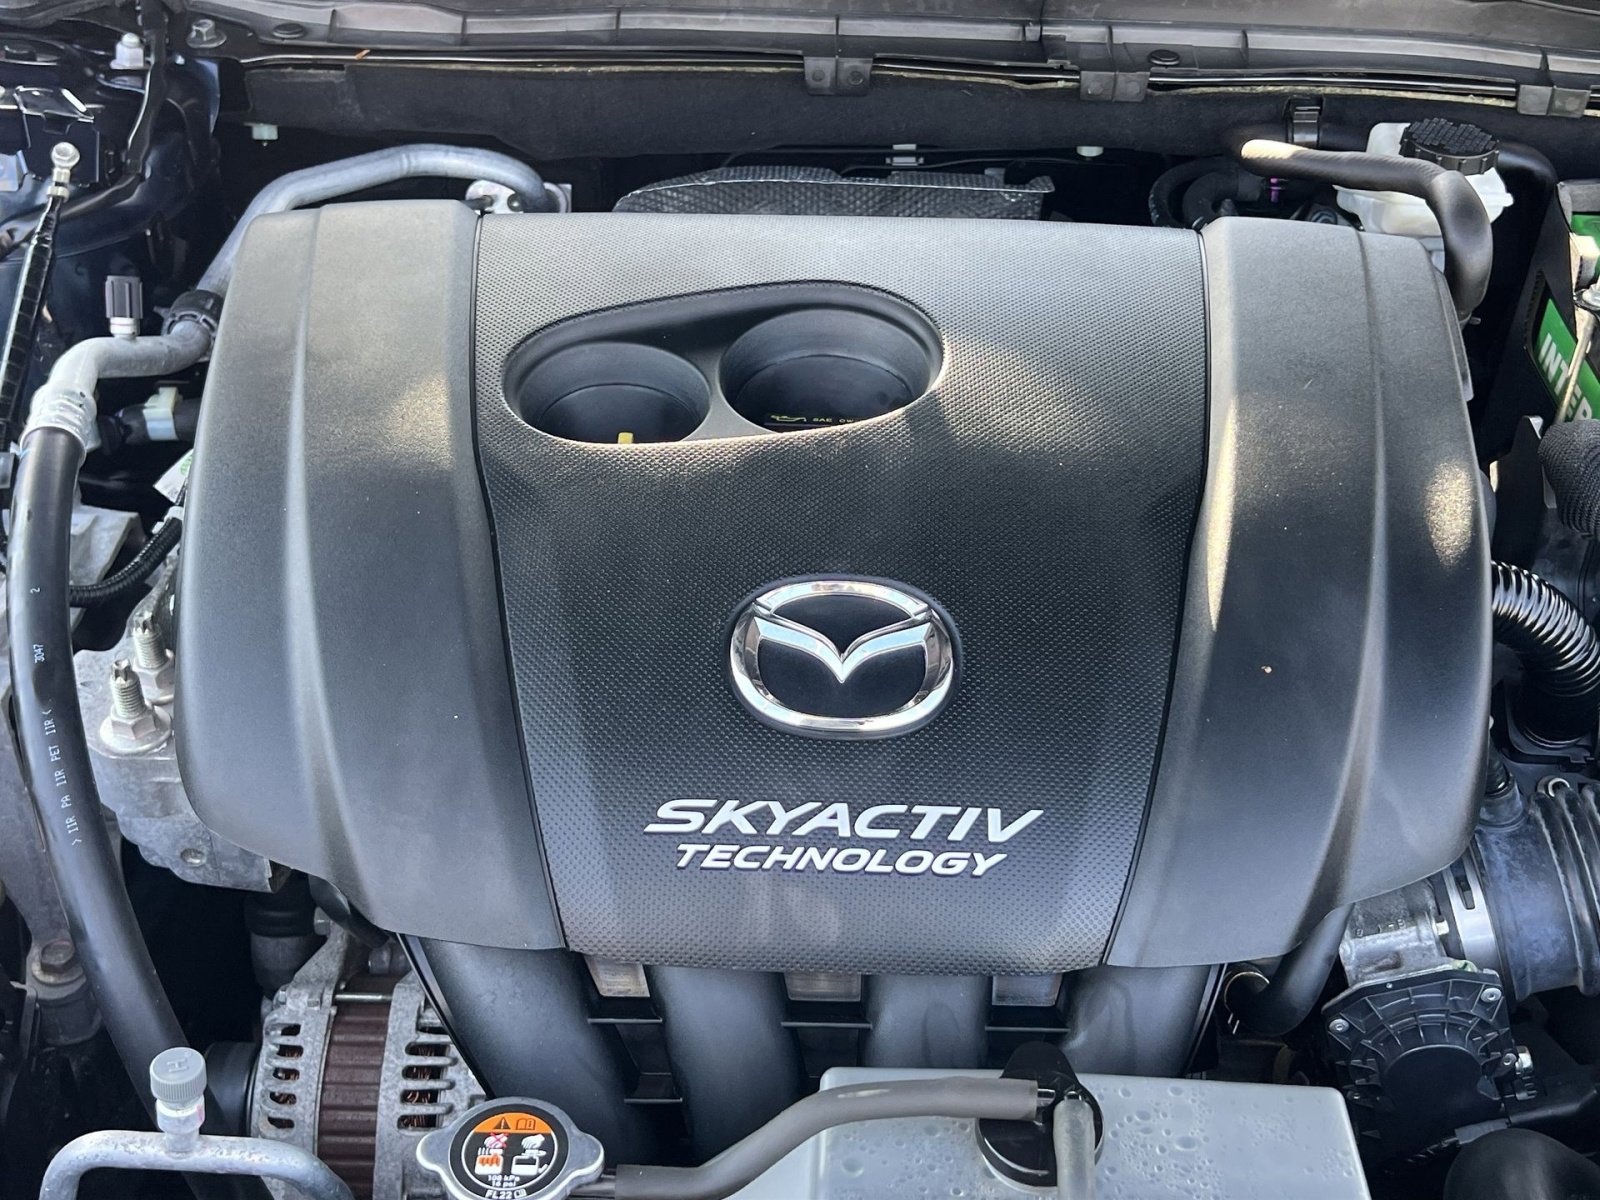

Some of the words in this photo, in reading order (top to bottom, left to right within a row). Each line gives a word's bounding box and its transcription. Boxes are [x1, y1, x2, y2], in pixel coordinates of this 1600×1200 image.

[643, 798, 1045, 843] SKYACTIV
[675, 843, 1008, 877] TECHNOLOGY
[485, 1189, 512, 1199] FL22
